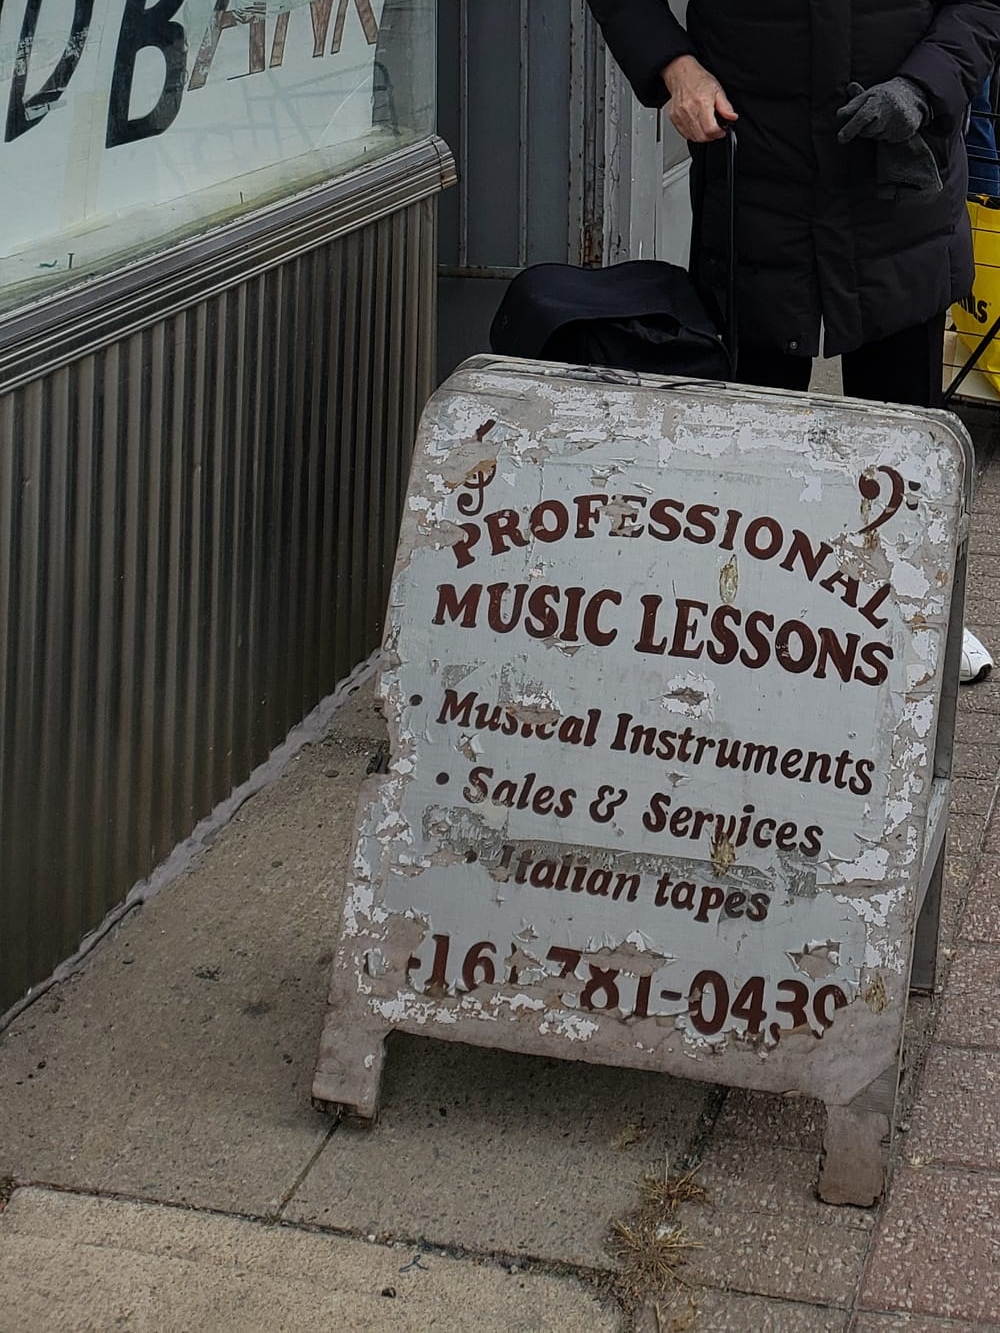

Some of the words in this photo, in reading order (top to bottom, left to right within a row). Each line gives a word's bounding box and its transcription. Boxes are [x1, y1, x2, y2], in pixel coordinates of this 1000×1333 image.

[453, 494, 893, 630] PROFESSIONAL
[432, 583, 621, 647] MUSIC
[633, 594, 895, 686] LESSONS
[610, 712, 876, 796] Instruments
[462, 765, 577, 819] Sales
[588, 785, 627, 824] &
[642, 792, 824, 858] Services
[654, 872, 771, 923] tapes
